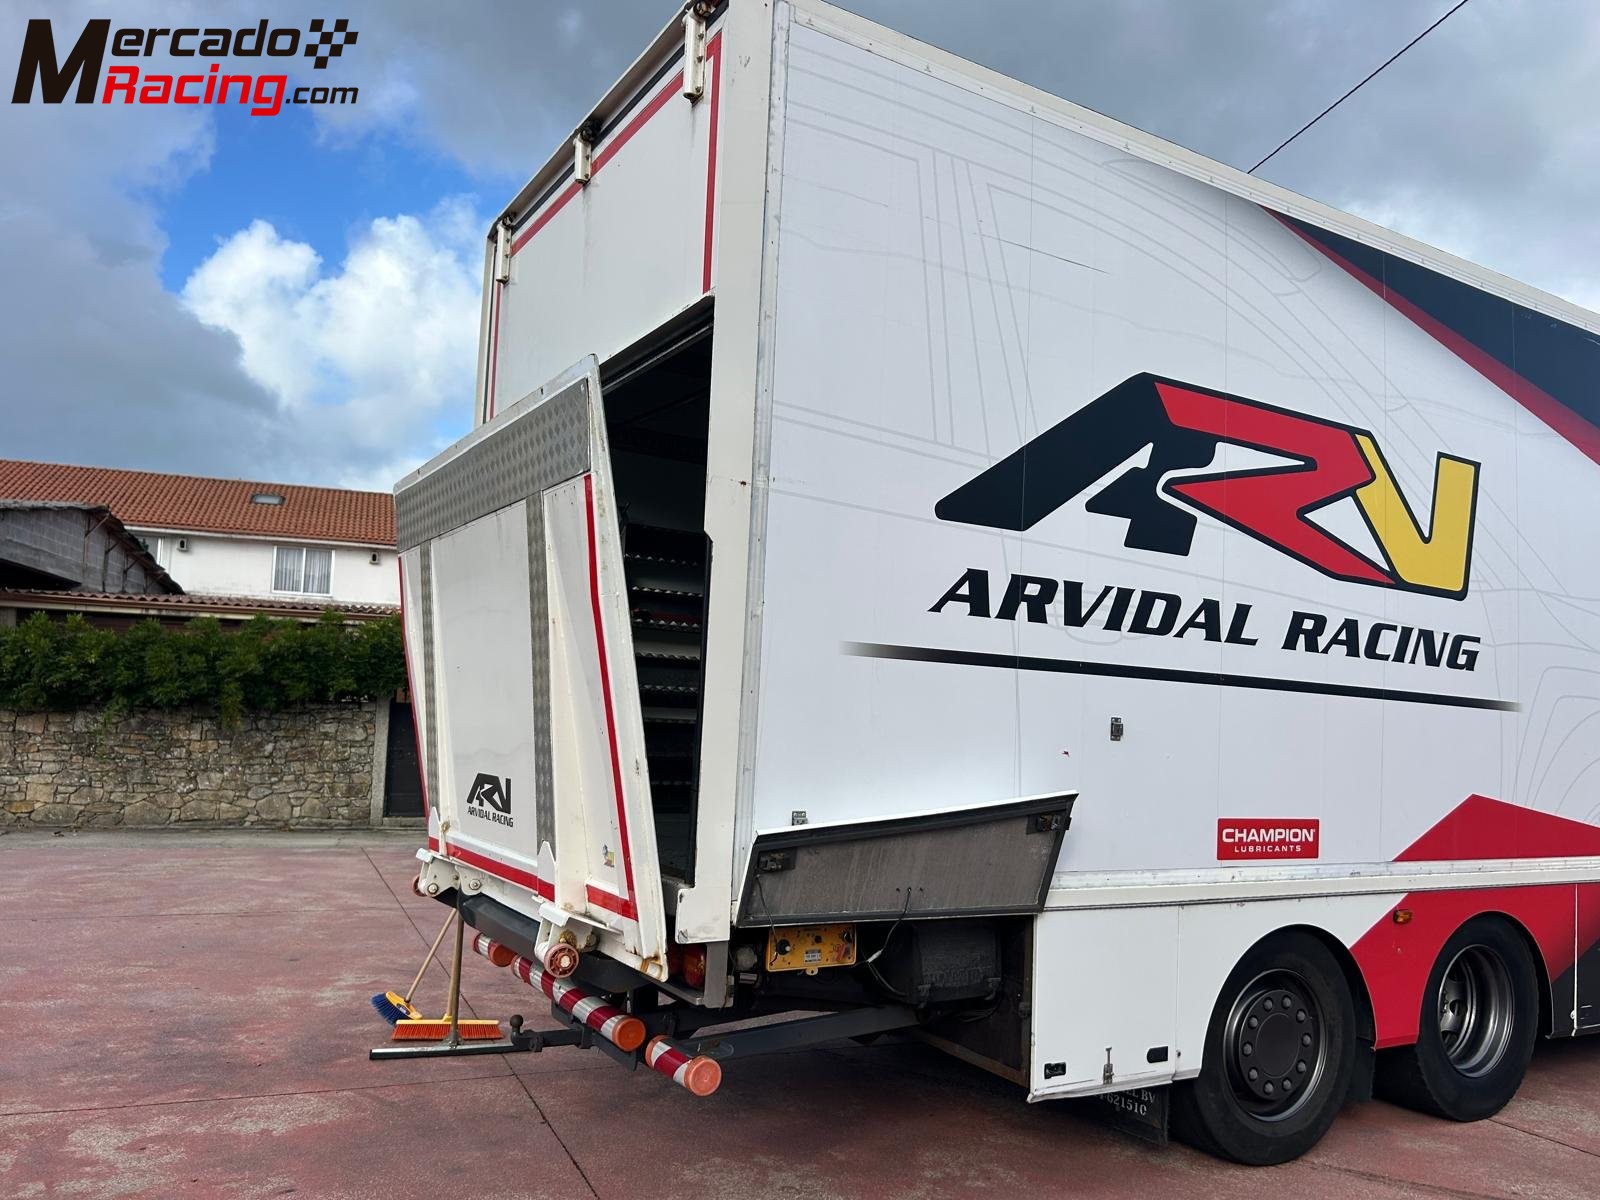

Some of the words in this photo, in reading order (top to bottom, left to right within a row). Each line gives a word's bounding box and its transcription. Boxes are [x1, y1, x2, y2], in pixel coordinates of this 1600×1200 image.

[935, 371, 1482, 601] ARV
[928, 567, 1259, 647] ARVIDAL
[1281, 610, 1481, 672] RACING
[467, 805, 491, 821] ARVIDAL
[492, 812, 514, 828] RACING
[1222, 828, 1314, 843] CHAMPION
[1234, 845, 1302, 853] LUBRICANTS
